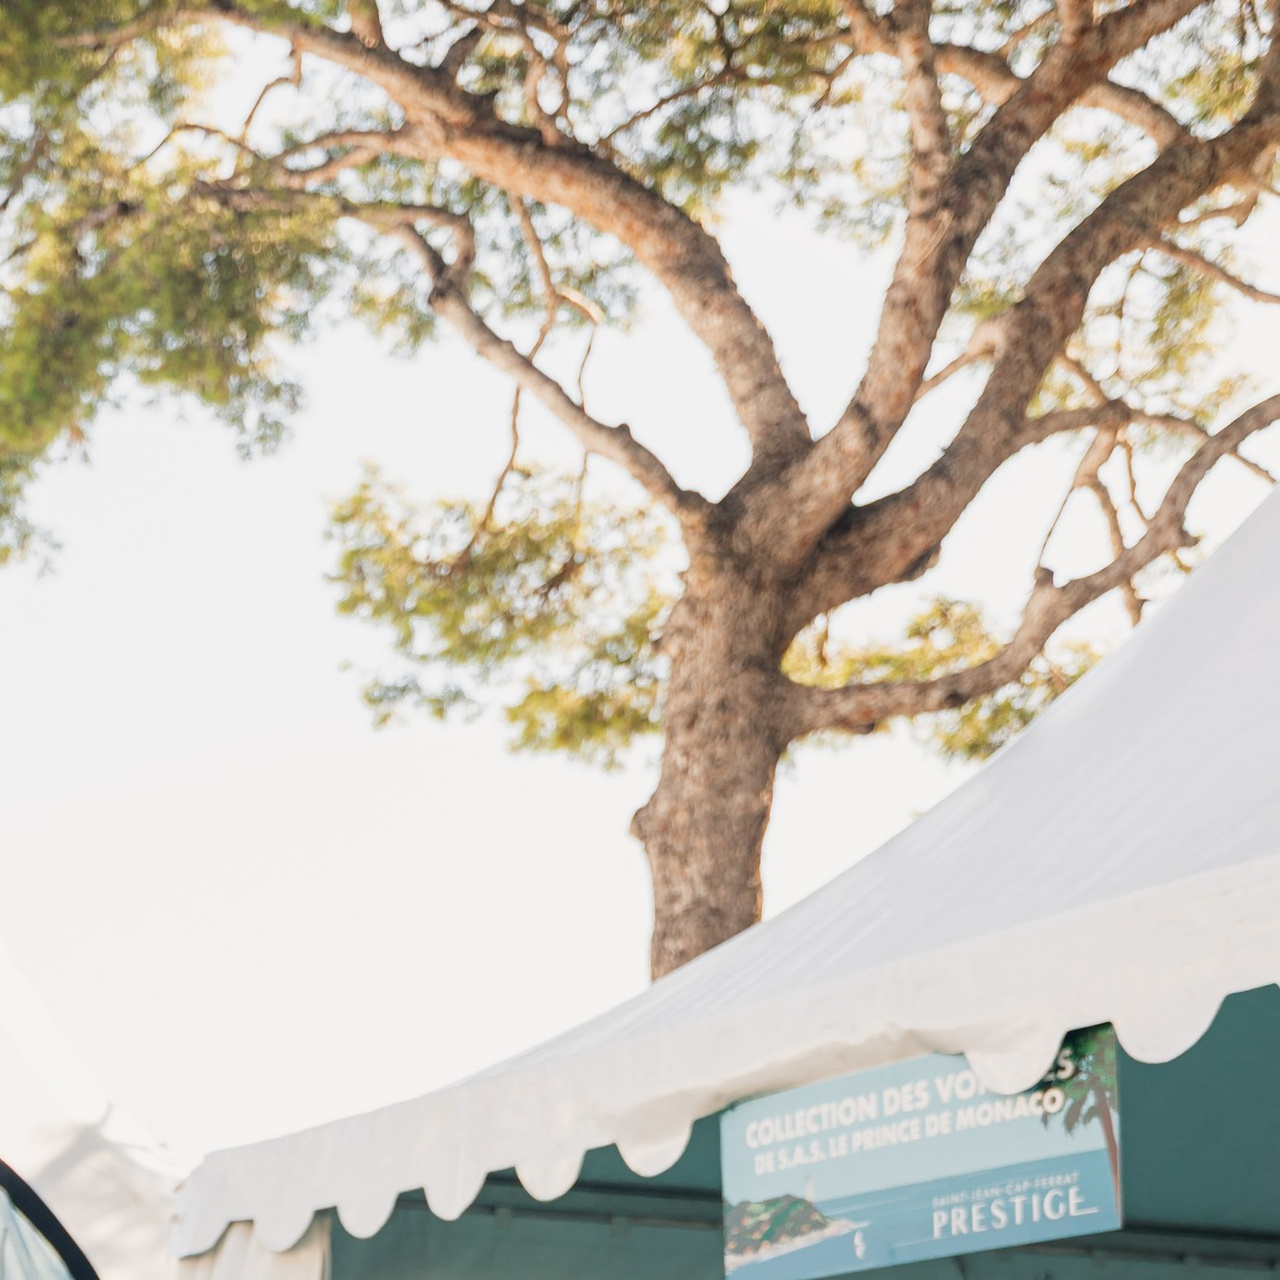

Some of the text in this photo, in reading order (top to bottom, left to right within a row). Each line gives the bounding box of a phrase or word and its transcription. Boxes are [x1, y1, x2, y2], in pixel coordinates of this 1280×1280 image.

[745, 1080, 930, 1149] COLLECTION DES
[754, 1152, 775, 1175] DE
[829, 1134, 849, 1158] LE
[851, 1117, 921, 1153] PRINCE
[924, 1110, 951, 1138] DE
[956, 1087, 1064, 1132] MONACO
[932, 1186, 1100, 1239] PRESTIGE
